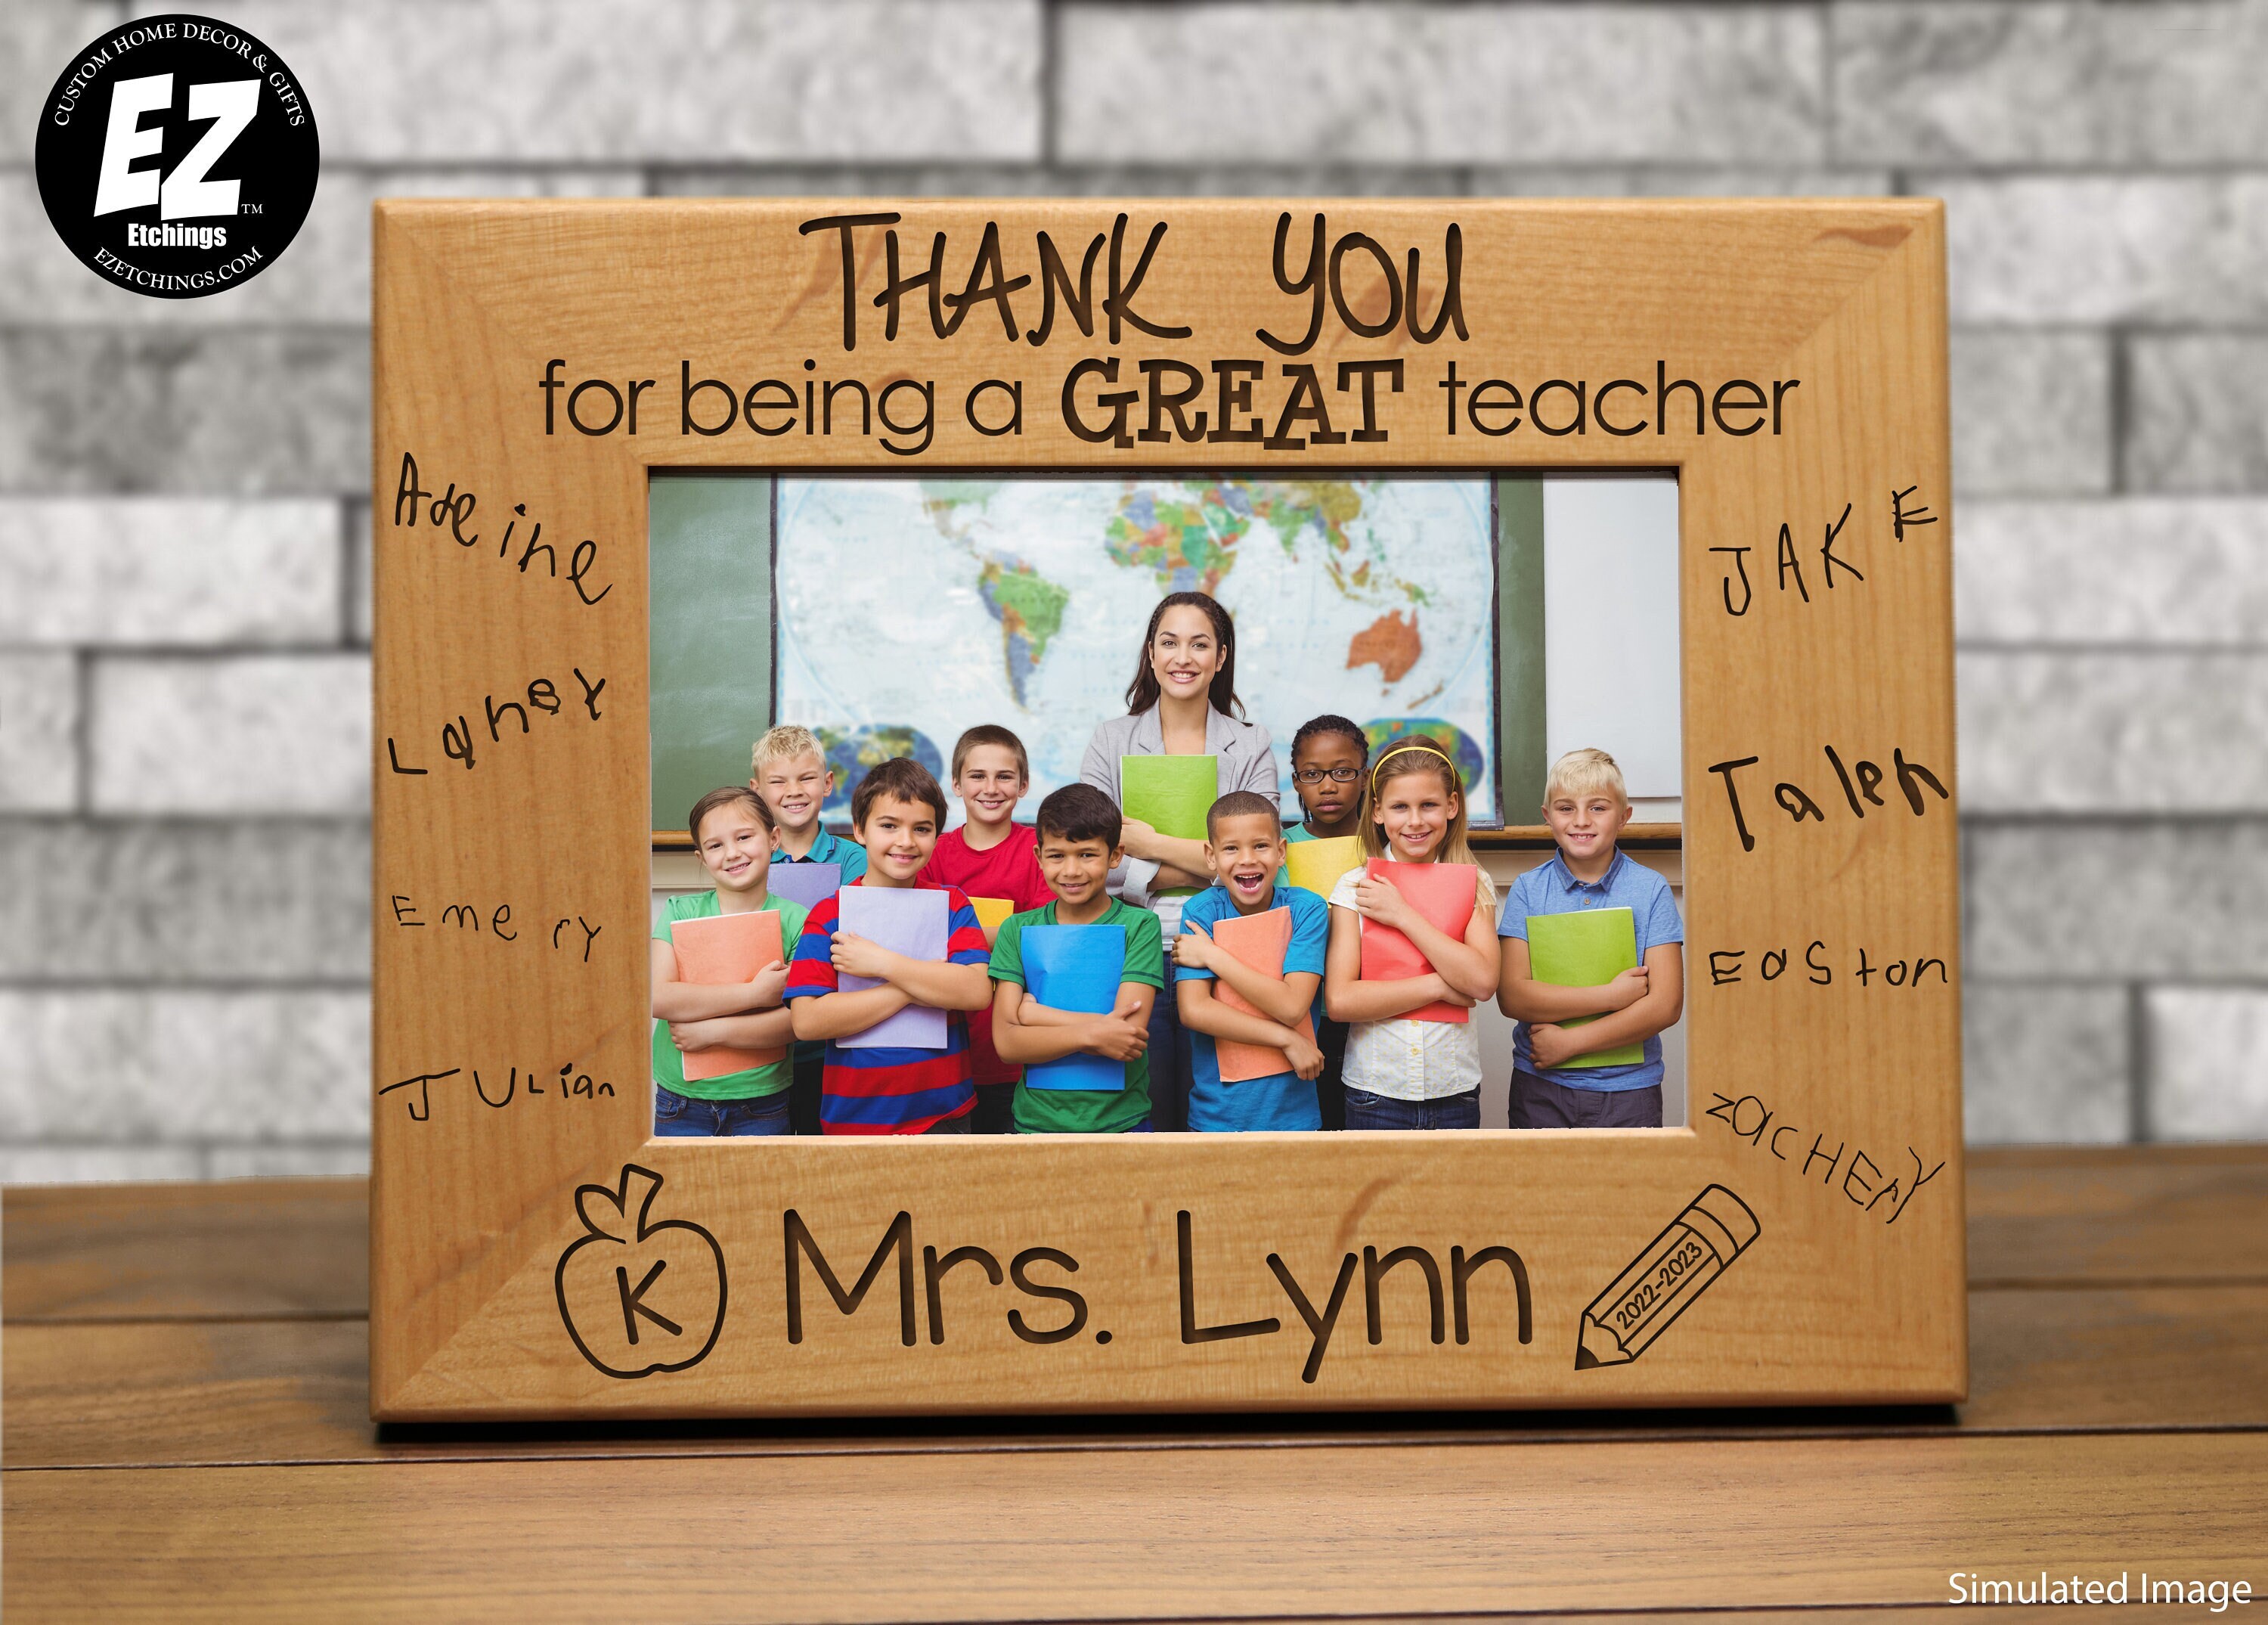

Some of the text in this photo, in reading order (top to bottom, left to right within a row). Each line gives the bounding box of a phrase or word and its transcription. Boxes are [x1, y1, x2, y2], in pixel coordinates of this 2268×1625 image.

[798, 212, 1193, 352] THANK
[538, 356, 1801, 456] for being a GREAT teacher
[1709, 485, 1938, 616] JAKE
[392, 895, 602, 963] Emery
[615, 1259, 683, 1345] K
[783, 1208, 1532, 1384] Mrs. Lynn
[1616, 1241, 1703, 1330] 2022-2023
